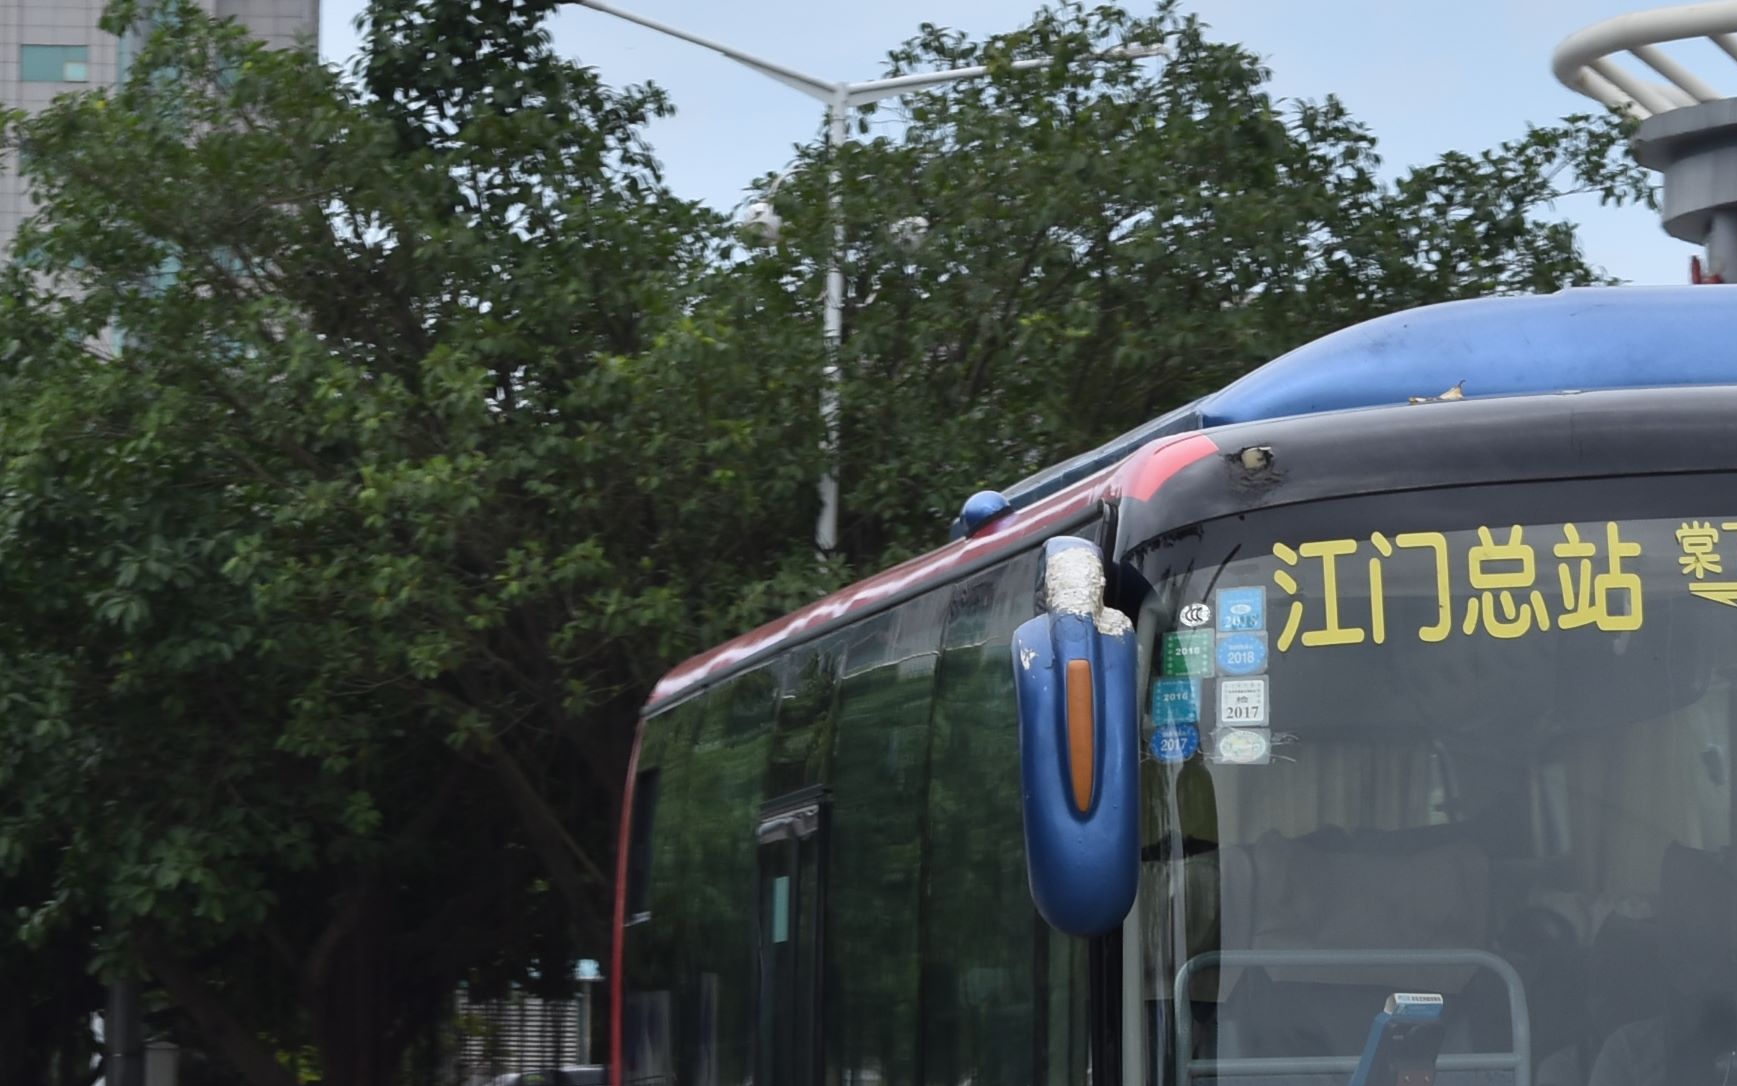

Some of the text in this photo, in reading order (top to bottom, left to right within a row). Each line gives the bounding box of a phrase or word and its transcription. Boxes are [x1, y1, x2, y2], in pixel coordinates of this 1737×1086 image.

[1273, 521, 1643, 652] 江门总站
[1227, 650, 1255, 665] 2018
[1226, 706, 1259, 719] 2017
[1160, 738, 1187, 752] 2017
